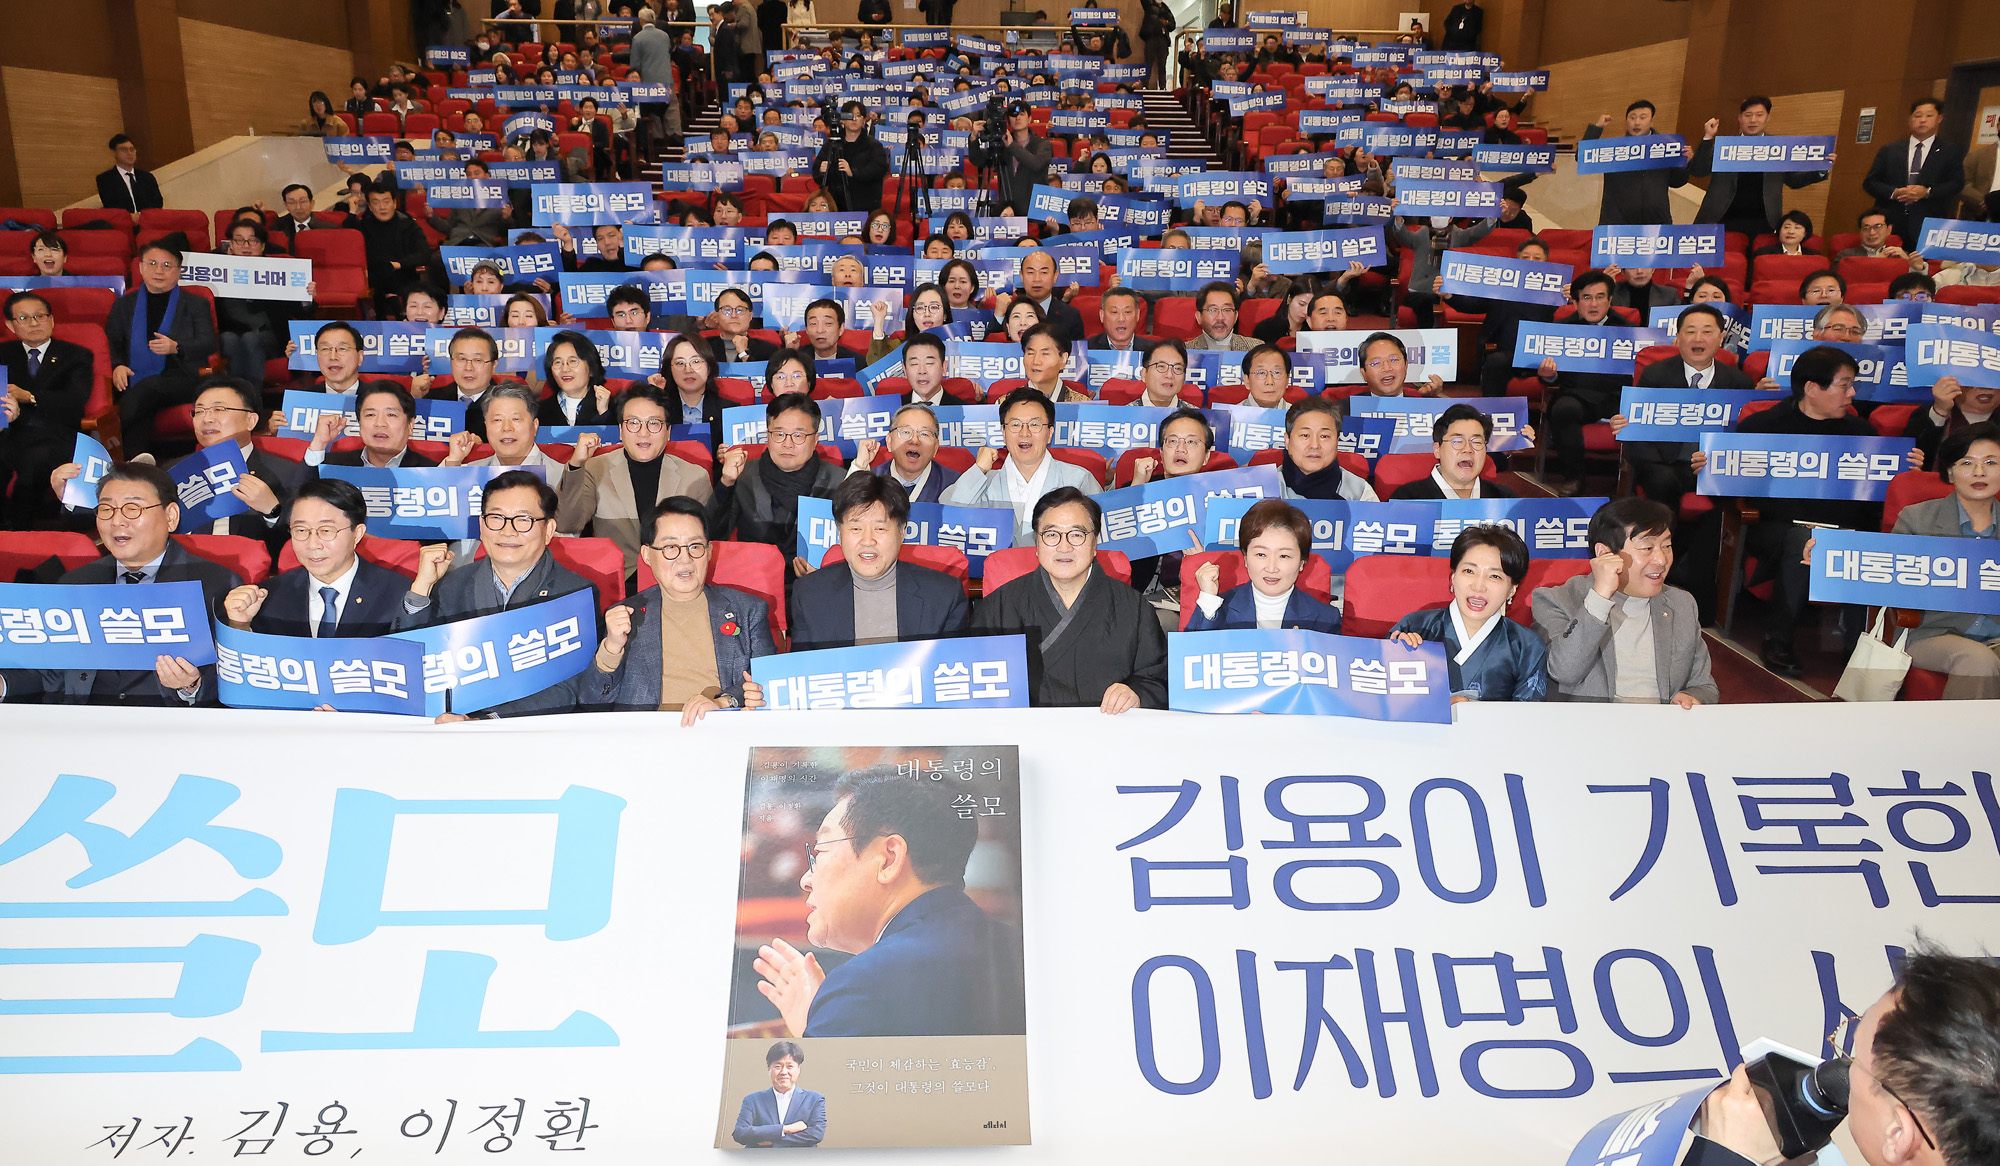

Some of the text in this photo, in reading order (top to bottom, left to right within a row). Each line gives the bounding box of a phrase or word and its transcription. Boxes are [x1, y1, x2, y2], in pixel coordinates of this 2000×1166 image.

[366, 142, 392, 157] 쓸모
[1366, 132, 1438, 148] 대통령의 쓸모
[1476, 150, 1551, 165] 대통령의 쓸모
[1583, 142, 1681, 164] 대통령의 쓸모
[1719, 145, 1826, 161] 대통령의 쓸모
[531, 167, 556, 180] 쓸모
[666, 169, 713, 184] 대통령의
[1396, 165, 1475, 180] 대통령의 쓸모
[430, 185, 474, 200] 대통령의
[1183, 179, 1269, 198] 대통령의 쓸모
[1338, 179, 1362, 192] 쓸모
[538, 193, 646, 214] 대통령의 쓸모
[1324, 201, 1392, 218] 대통령의 쓸모
[1400, 190, 1496, 207] 대통령의 쓸모
[833, 221, 863, 237] 쓸모
[993, 224, 1021, 241] 쓸모
[627, 236, 696, 258] 대통령의
[701, 237, 737, 258] 쓸모
[1269, 236, 1378, 262] 대통령의 쓸모
[1597, 235, 1717, 255] 대통령의 쓸모
[180, 265, 307, 287] 김용의 꿈 너머 꿈
[517, 253, 556, 276] 쓸모
[871, 265, 907, 284] 쓸모
[1058, 256, 1092, 275] 쓸모
[1123, 258, 1232, 278] 대통령의 쓸모
[1446, 262, 1564, 294] 대통령의 쓸모
[648, 282, 687, 304] 쓸모
[1431, 344, 1451, 367] 꿈
[1523, 334, 1607, 360] 대통령의
[1628, 402, 1732, 427] 대통령의
[840, 411, 890, 442] 쓸모
[1054, 420, 1157, 449] 대통령의
[1710, 449, 1900, 482] 대통령의 쓸모
[177, 460, 240, 510] 쓸모
[358, 485, 459, 519] 통령의
[937, 523, 998, 557] 쓸모
[1352, 520, 1418, 555] 쓸모
[1535, 517, 1591, 549] 쓸모
[1825, 548, 1969, 589] 대통령의
[0, 606, 191, 645] 령의 쓸모
[422, 615, 582, 695] 령의 쓸모
[216, 640, 409, 700] 통령의 쓸모
[1183, 650, 1431, 696] 대통령의 쓸모
[769, 660, 1011, 710] 대통령의 쓸모
[897, 757, 1002, 781] 대통령의
[950, 793, 1007, 819] 쓸모
[1115, 769, 2000, 912] 김용이 기록한
[0, 773, 628, 1075] 쓸모
[1131, 944, 1742, 1100] 이재명의
[845, 1057, 884, 1073] 국민이
[888, 1057, 941, 1072] 체감하는
[851, 1079, 990, 1095] 그것이 대통령의 쓸모다
[85, 1096, 600, 1159] 저자. 김용, 이정환
